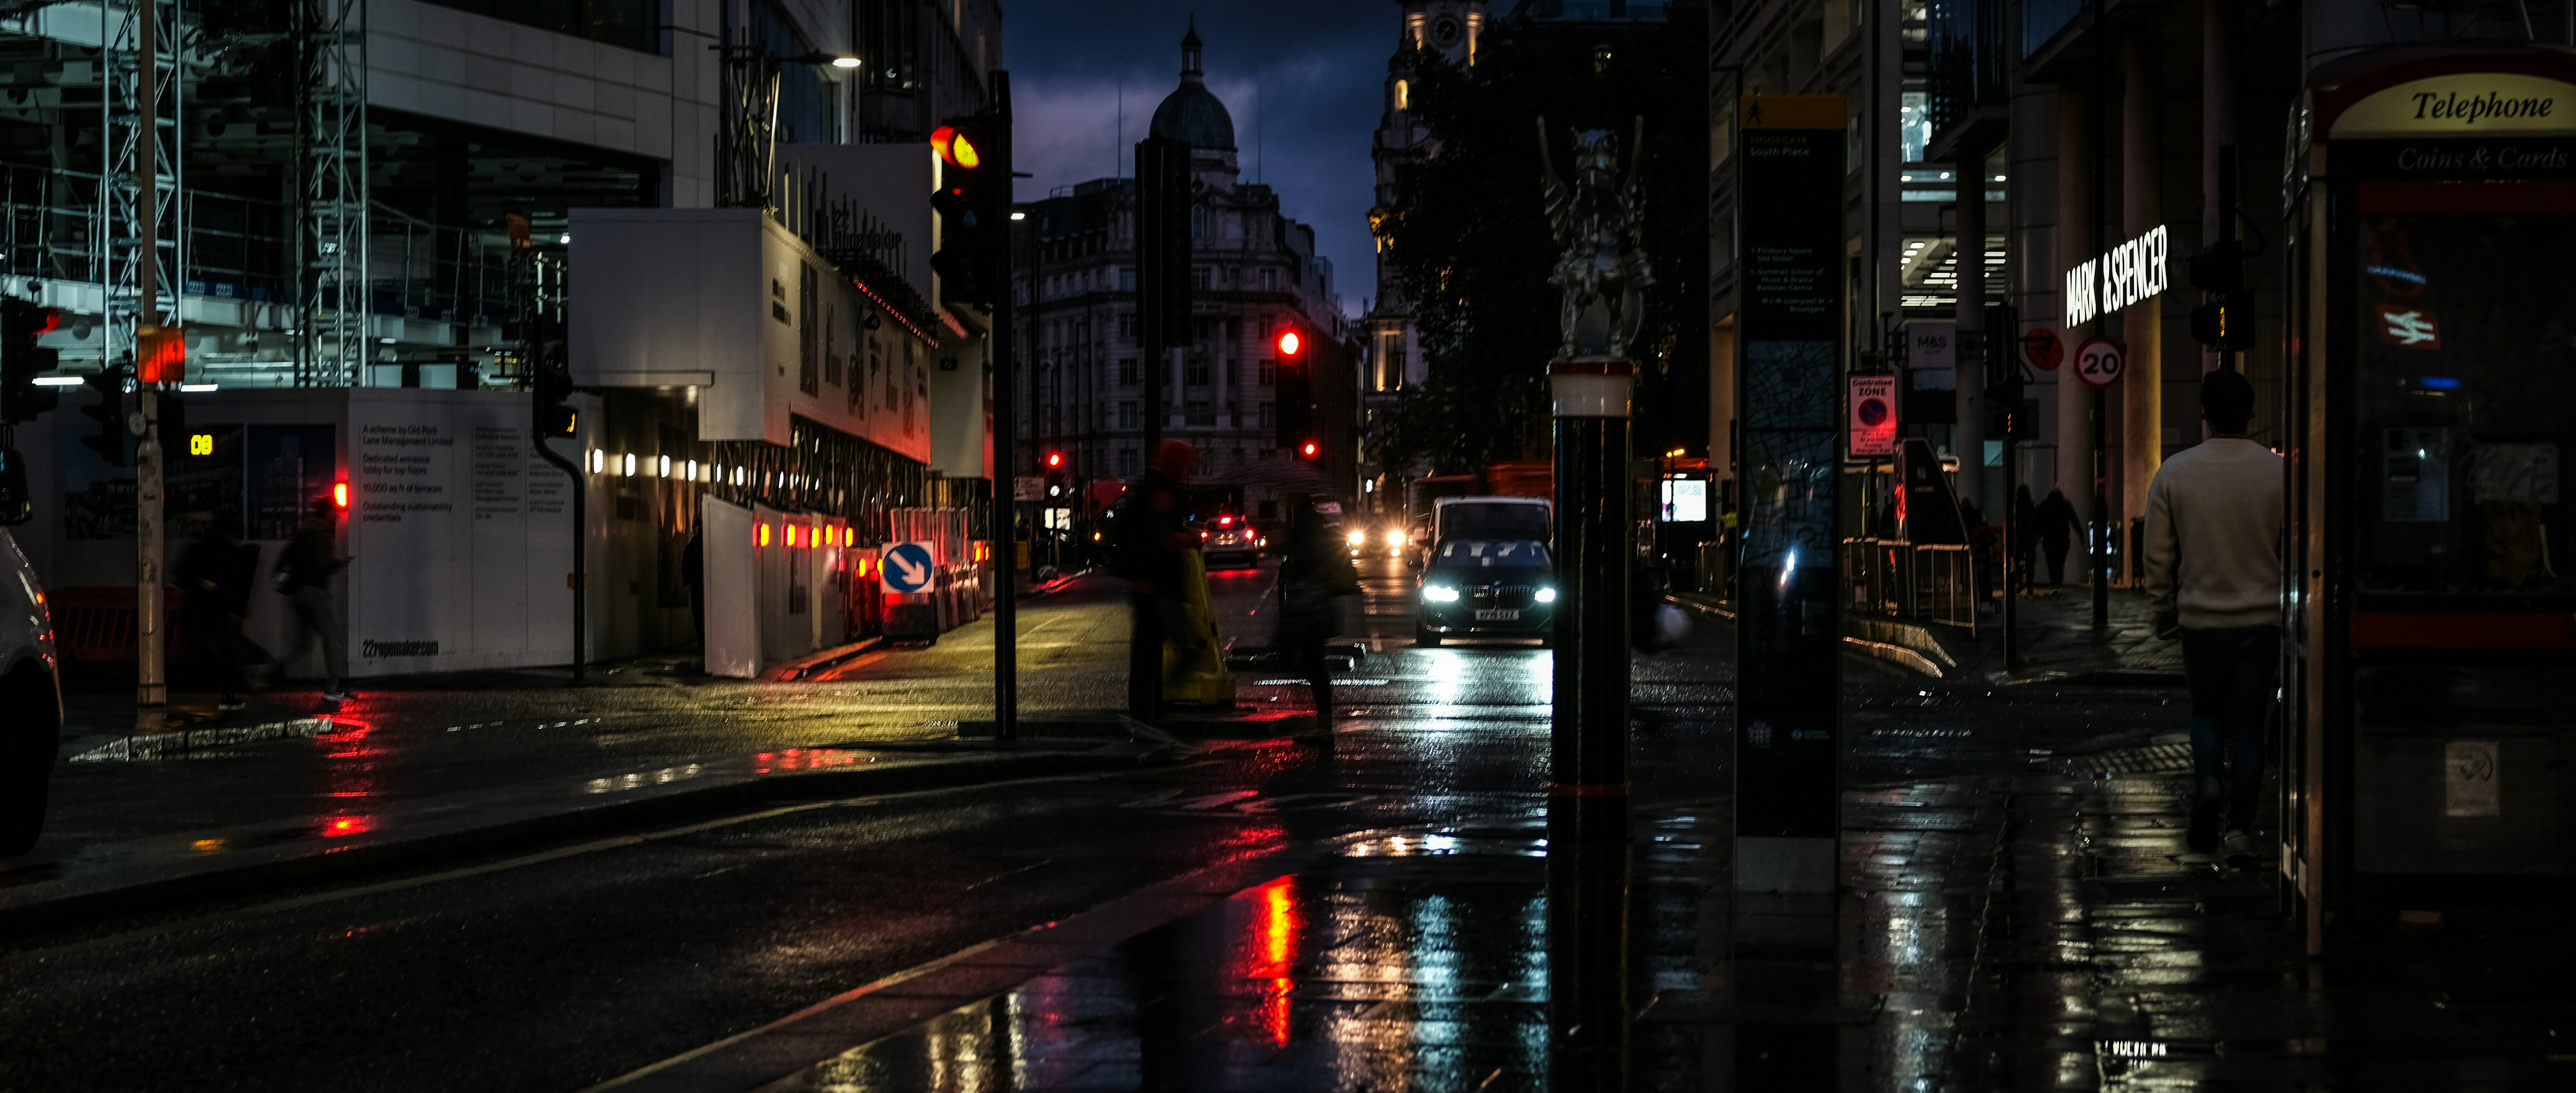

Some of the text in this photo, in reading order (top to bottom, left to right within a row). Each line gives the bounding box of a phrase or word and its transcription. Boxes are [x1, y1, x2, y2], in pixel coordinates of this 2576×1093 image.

[2412, 91, 2553, 124] Telephone
[1750, 135, 1808, 145] MOORGATE
[1750, 146, 1810, 156] South Place
[2398, 145, 2569, 171] Coins & Cards
[2067, 257, 2096, 330] MARK
[1918, 335, 1947, 349] M&S
[2083, 353, 2119, 375] 20
[1852, 379, 1893, 387] Controlled
[1858, 387, 1887, 396] ZONE
[363, 424, 438, 436] A scheme by Old Park
[191, 434, 212, 455] 08
[363, 435, 453, 448] Lane Management Limited
[363, 453, 430, 464] Dedicated entrance
[363, 465, 427, 477] lobby for top floors
[406, 483, 414, 493] of
[414, 484, 443, 493] terraces
[363, 501, 406, 513] Outstanding
[363, 513, 402, 523] credentials
[362, 638, 438, 661] 22ropemaker.com
